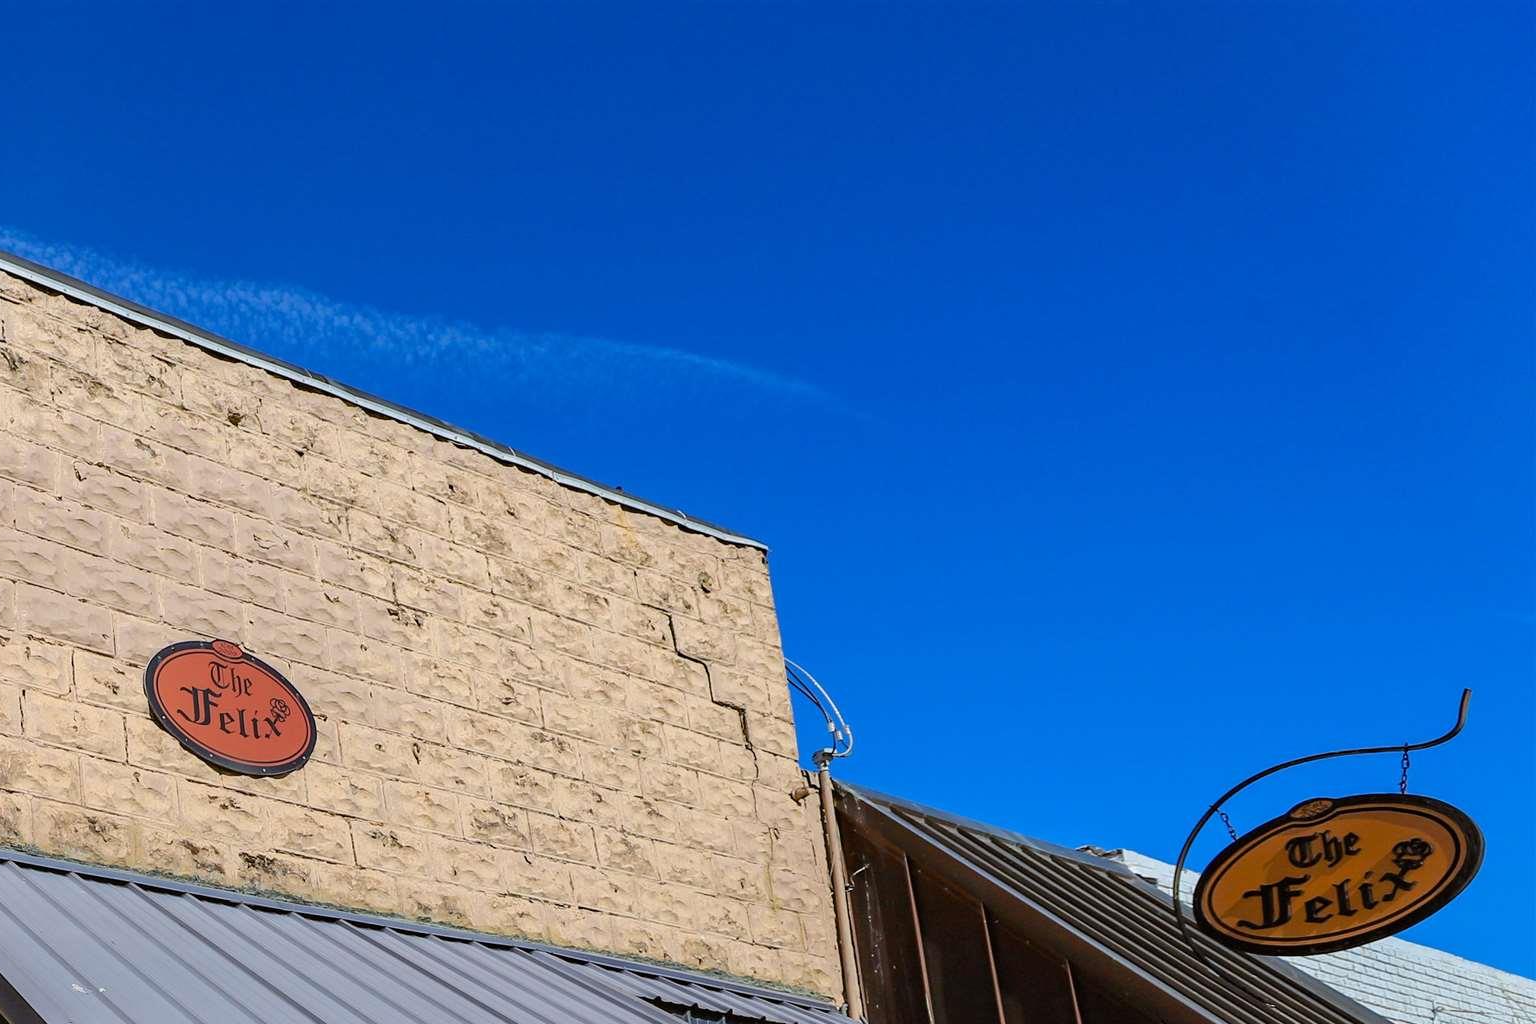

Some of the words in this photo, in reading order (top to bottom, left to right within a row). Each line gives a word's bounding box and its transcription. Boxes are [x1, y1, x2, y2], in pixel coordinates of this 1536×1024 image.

[208, 661, 253, 698] The
[177, 686, 283, 740] Felix
[1284, 830, 1362, 868] The
[1236, 870, 1418, 930] Felix
